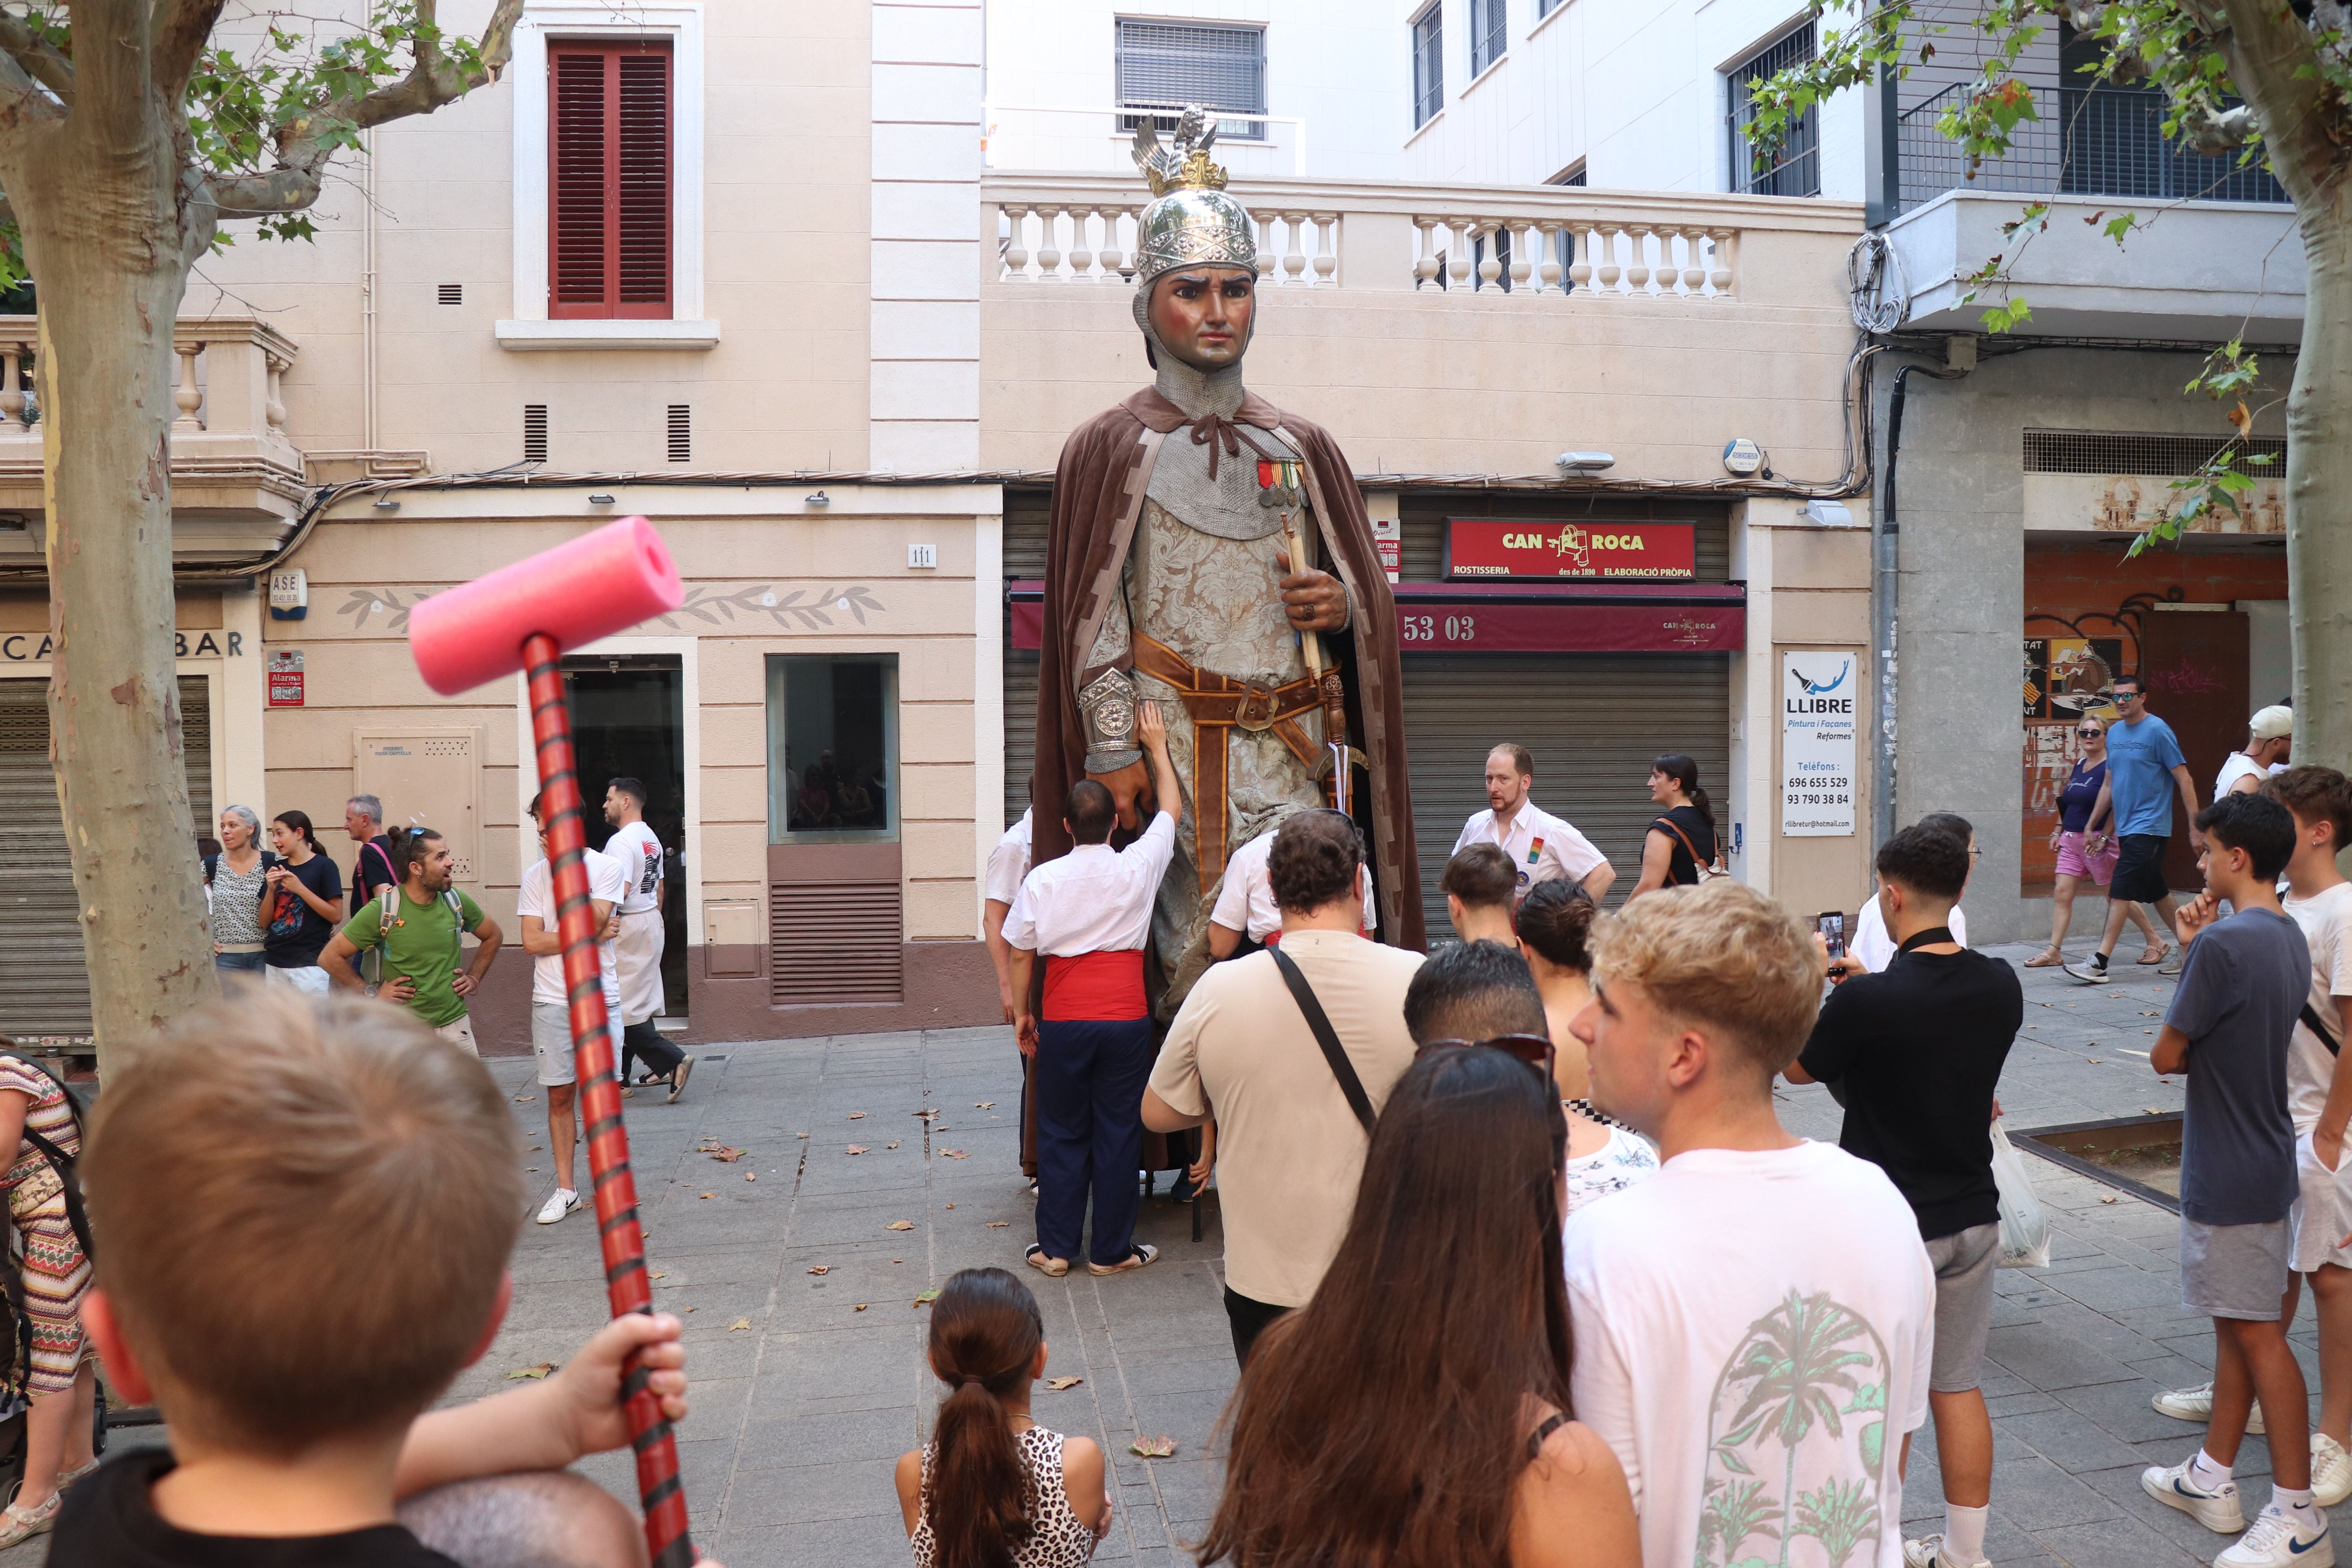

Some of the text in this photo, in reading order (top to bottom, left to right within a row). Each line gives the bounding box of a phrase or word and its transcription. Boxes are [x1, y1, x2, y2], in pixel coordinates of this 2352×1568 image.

[1373, 528, 1394, 536] Direct
[1502, 534, 1644, 550] CAN ROCA
[913, 549, 929, 563] 111
[1454, 566, 1510, 574] ROSTISSERIA
[1604, 567, 1691, 577] ELABORACIÓ PRÒPIA
[273, 576, 297, 590] A.S.E.
[1404, 616, 1474, 641] 53 03
[3, 632, 242, 660] CA BAR
[1787, 699, 1852, 713] LLIBRE
[1821, 720, 1851, 728] Façanes
[1817, 732, 1851, 741] Reformes
[1789, 778, 1847, 787] 696 655 529
[1788, 795, 1848, 804] 93 790 38 84
